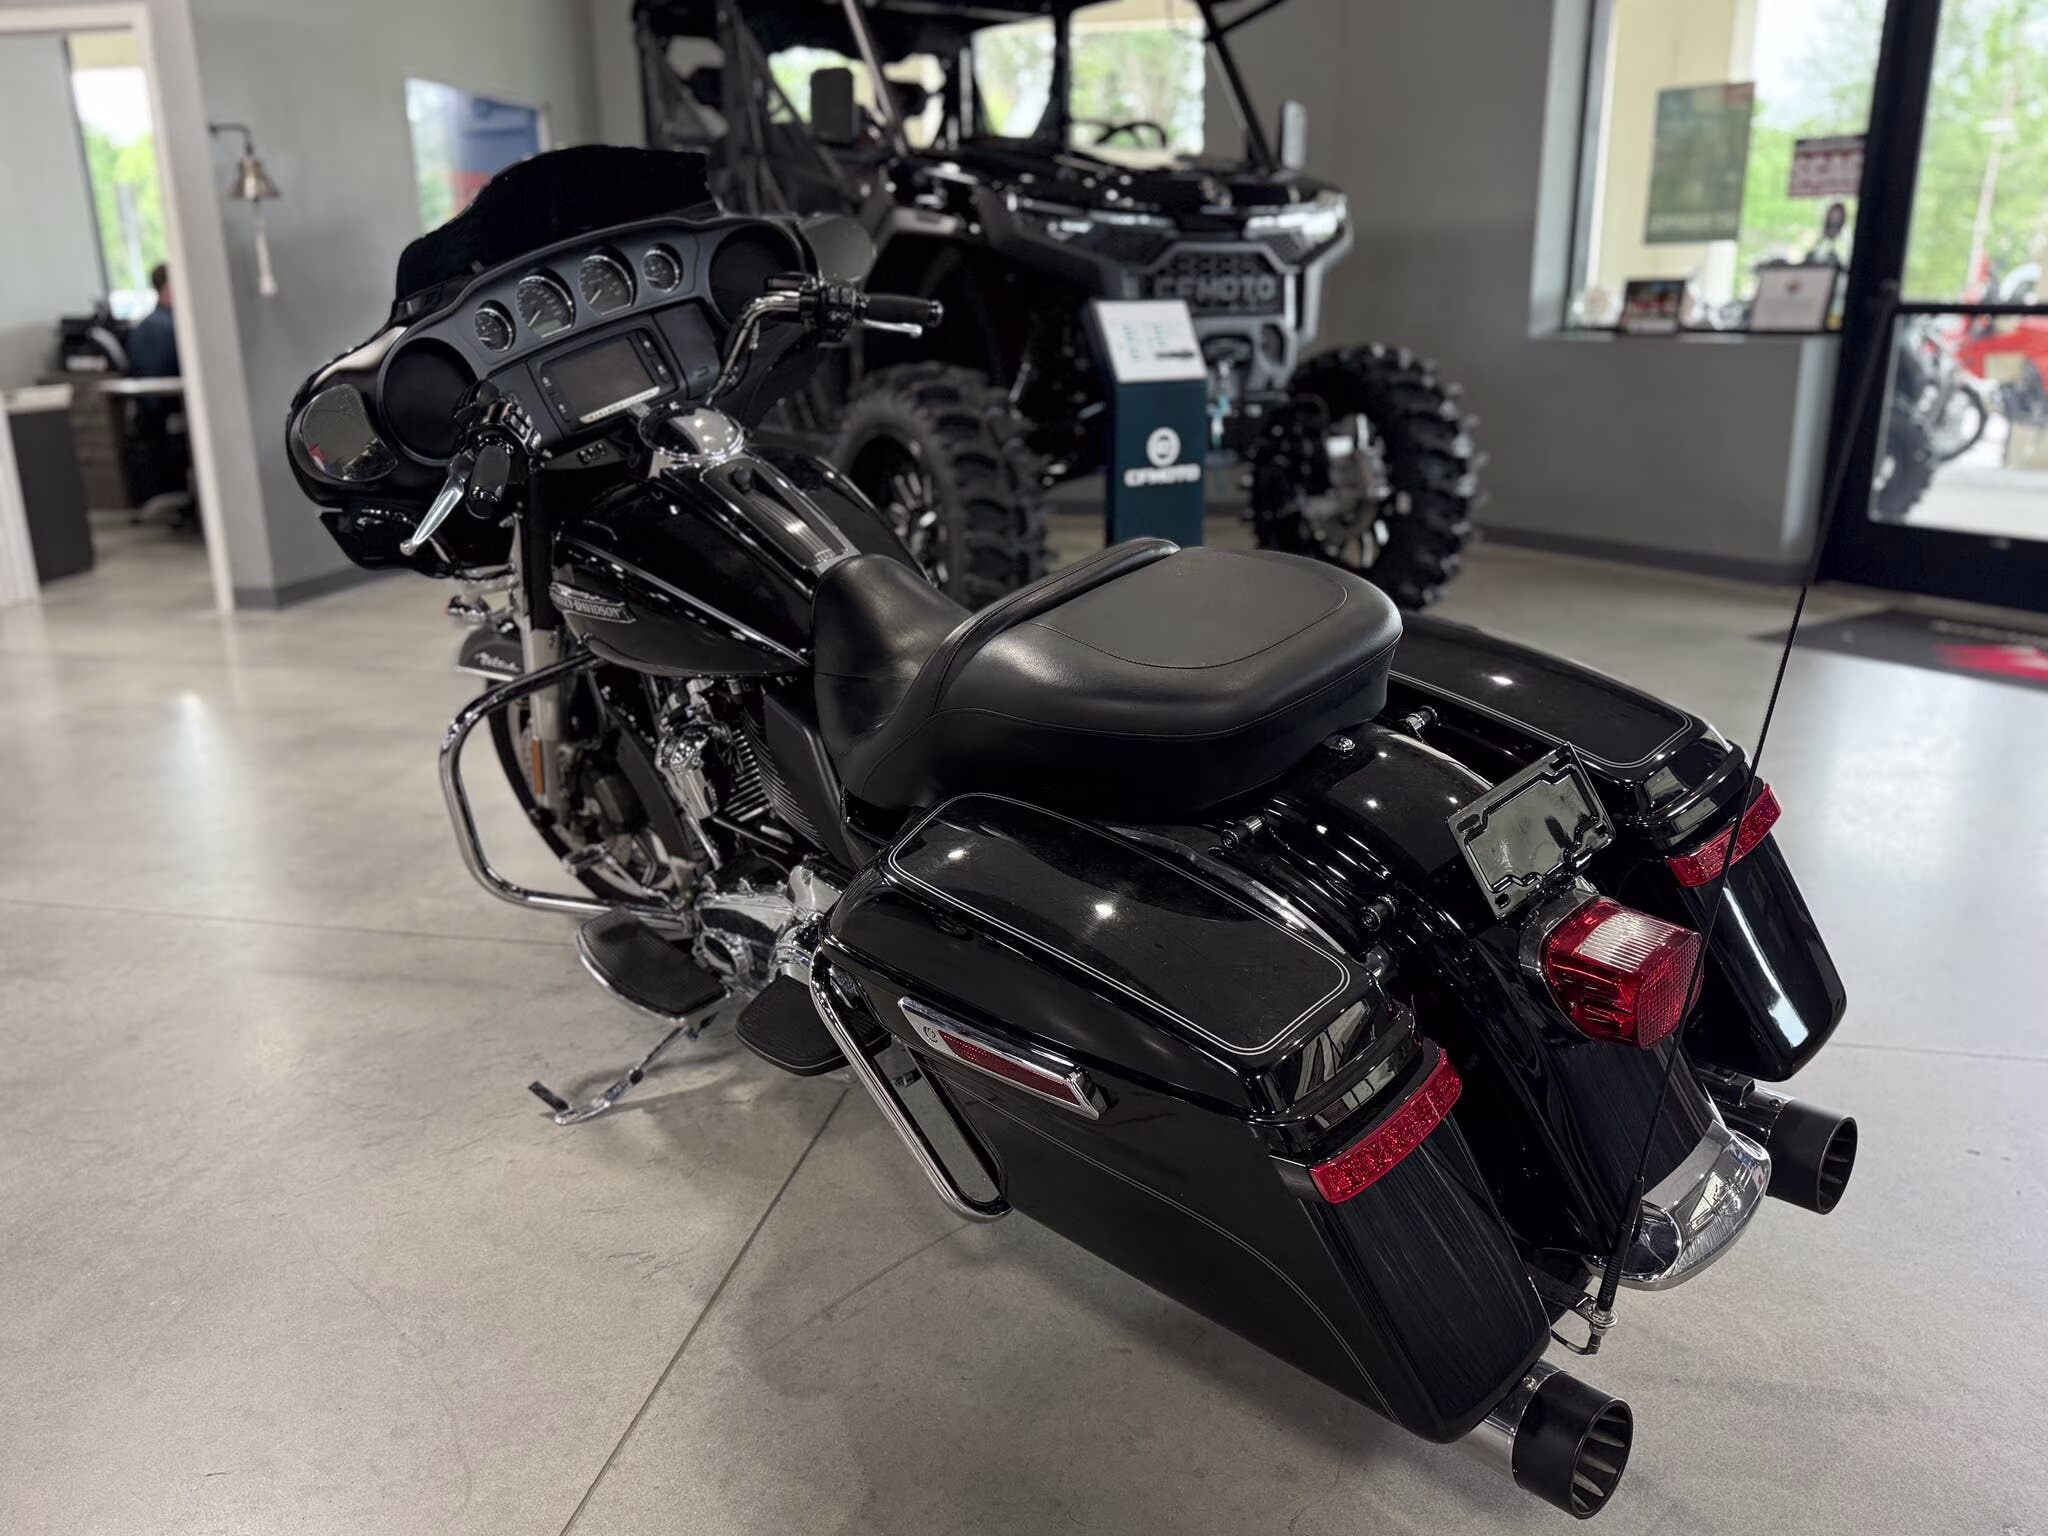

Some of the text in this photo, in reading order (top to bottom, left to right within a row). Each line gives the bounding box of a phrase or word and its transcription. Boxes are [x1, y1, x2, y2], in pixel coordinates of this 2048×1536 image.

[1154, 274, 1276, 300] CFMOTO
[1124, 464, 1201, 487] CFMOTO
[551, 593, 620, 618] LEY-DAVIDSON
